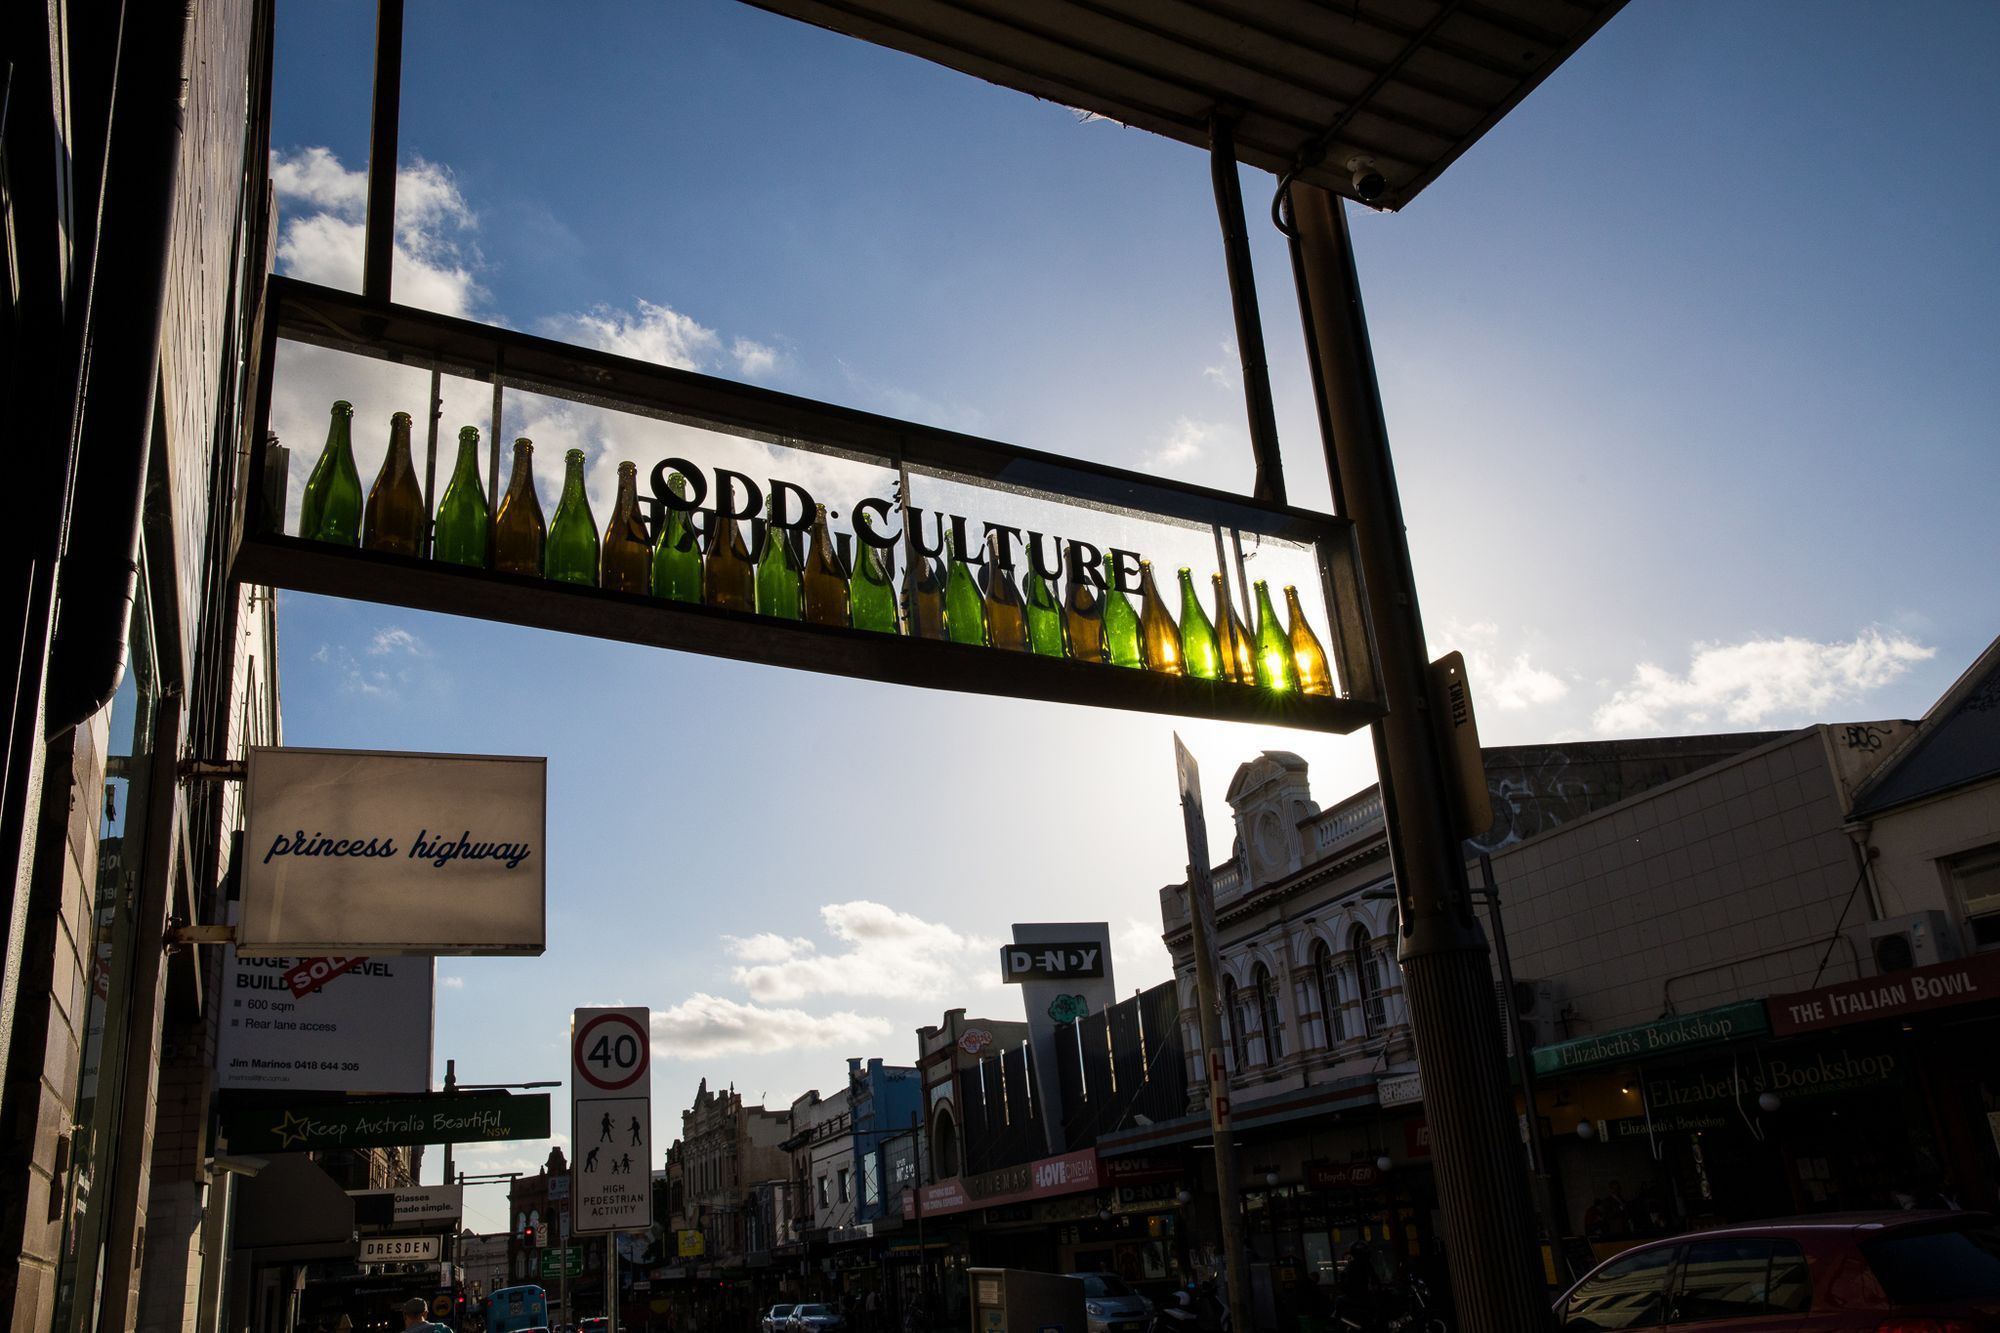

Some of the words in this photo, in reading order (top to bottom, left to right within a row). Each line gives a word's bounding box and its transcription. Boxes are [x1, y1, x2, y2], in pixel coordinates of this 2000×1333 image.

[650, 458, 816, 532] ODD
[852, 497, 1147, 596] CULTURE
[264, 830, 398, 864] princess
[408, 829, 531, 869] highway
[1011, 949, 1098, 973] DENDY
[293, 957, 348, 989] SOL
[1789, 1001, 1825, 1024] THE
[1828, 984, 1907, 1016] ITALIAN
[1911, 972, 1977, 1001] BOWL
[248, 1000, 268, 1010] 600
[271, 1003, 295, 1013] sqm
[245, 1018, 271, 1029] Rear
[274, 1019, 297, 1030] lane
[300, 1022, 337, 1032] access
[1562, 1033, 1641, 1066] Elizabeth's
[1645, 1017, 1732, 1050] Bookshop
[588, 1034, 637, 1068] 40
[229, 1059, 248, 1067] Jim
[251, 1059, 292, 1069] Marinos
[294, 1061, 318, 1070] 0418
[320, 1062, 338, 1070] 644
[341, 1062, 359, 1071] 305
[1769, 1049, 1896, 1091] Bookshop
[306, 1120, 348, 1144] Keep
[355, 1116, 425, 1135] Australia
[433, 1109, 501, 1134] Beautiful
[487, 1128, 511, 1137] NSW
[603, 1184, 625, 1193] HIGH
[394, 1195, 430, 1203] Glasses
[583, 1194, 644, 1206] PEDESTRIAN
[394, 1204, 419, 1213] made
[421, 1202, 453, 1213] simple.
[591, 1205, 636, 1216] ACTIVITY
[367, 1242, 430, 1255] DRESDEN
